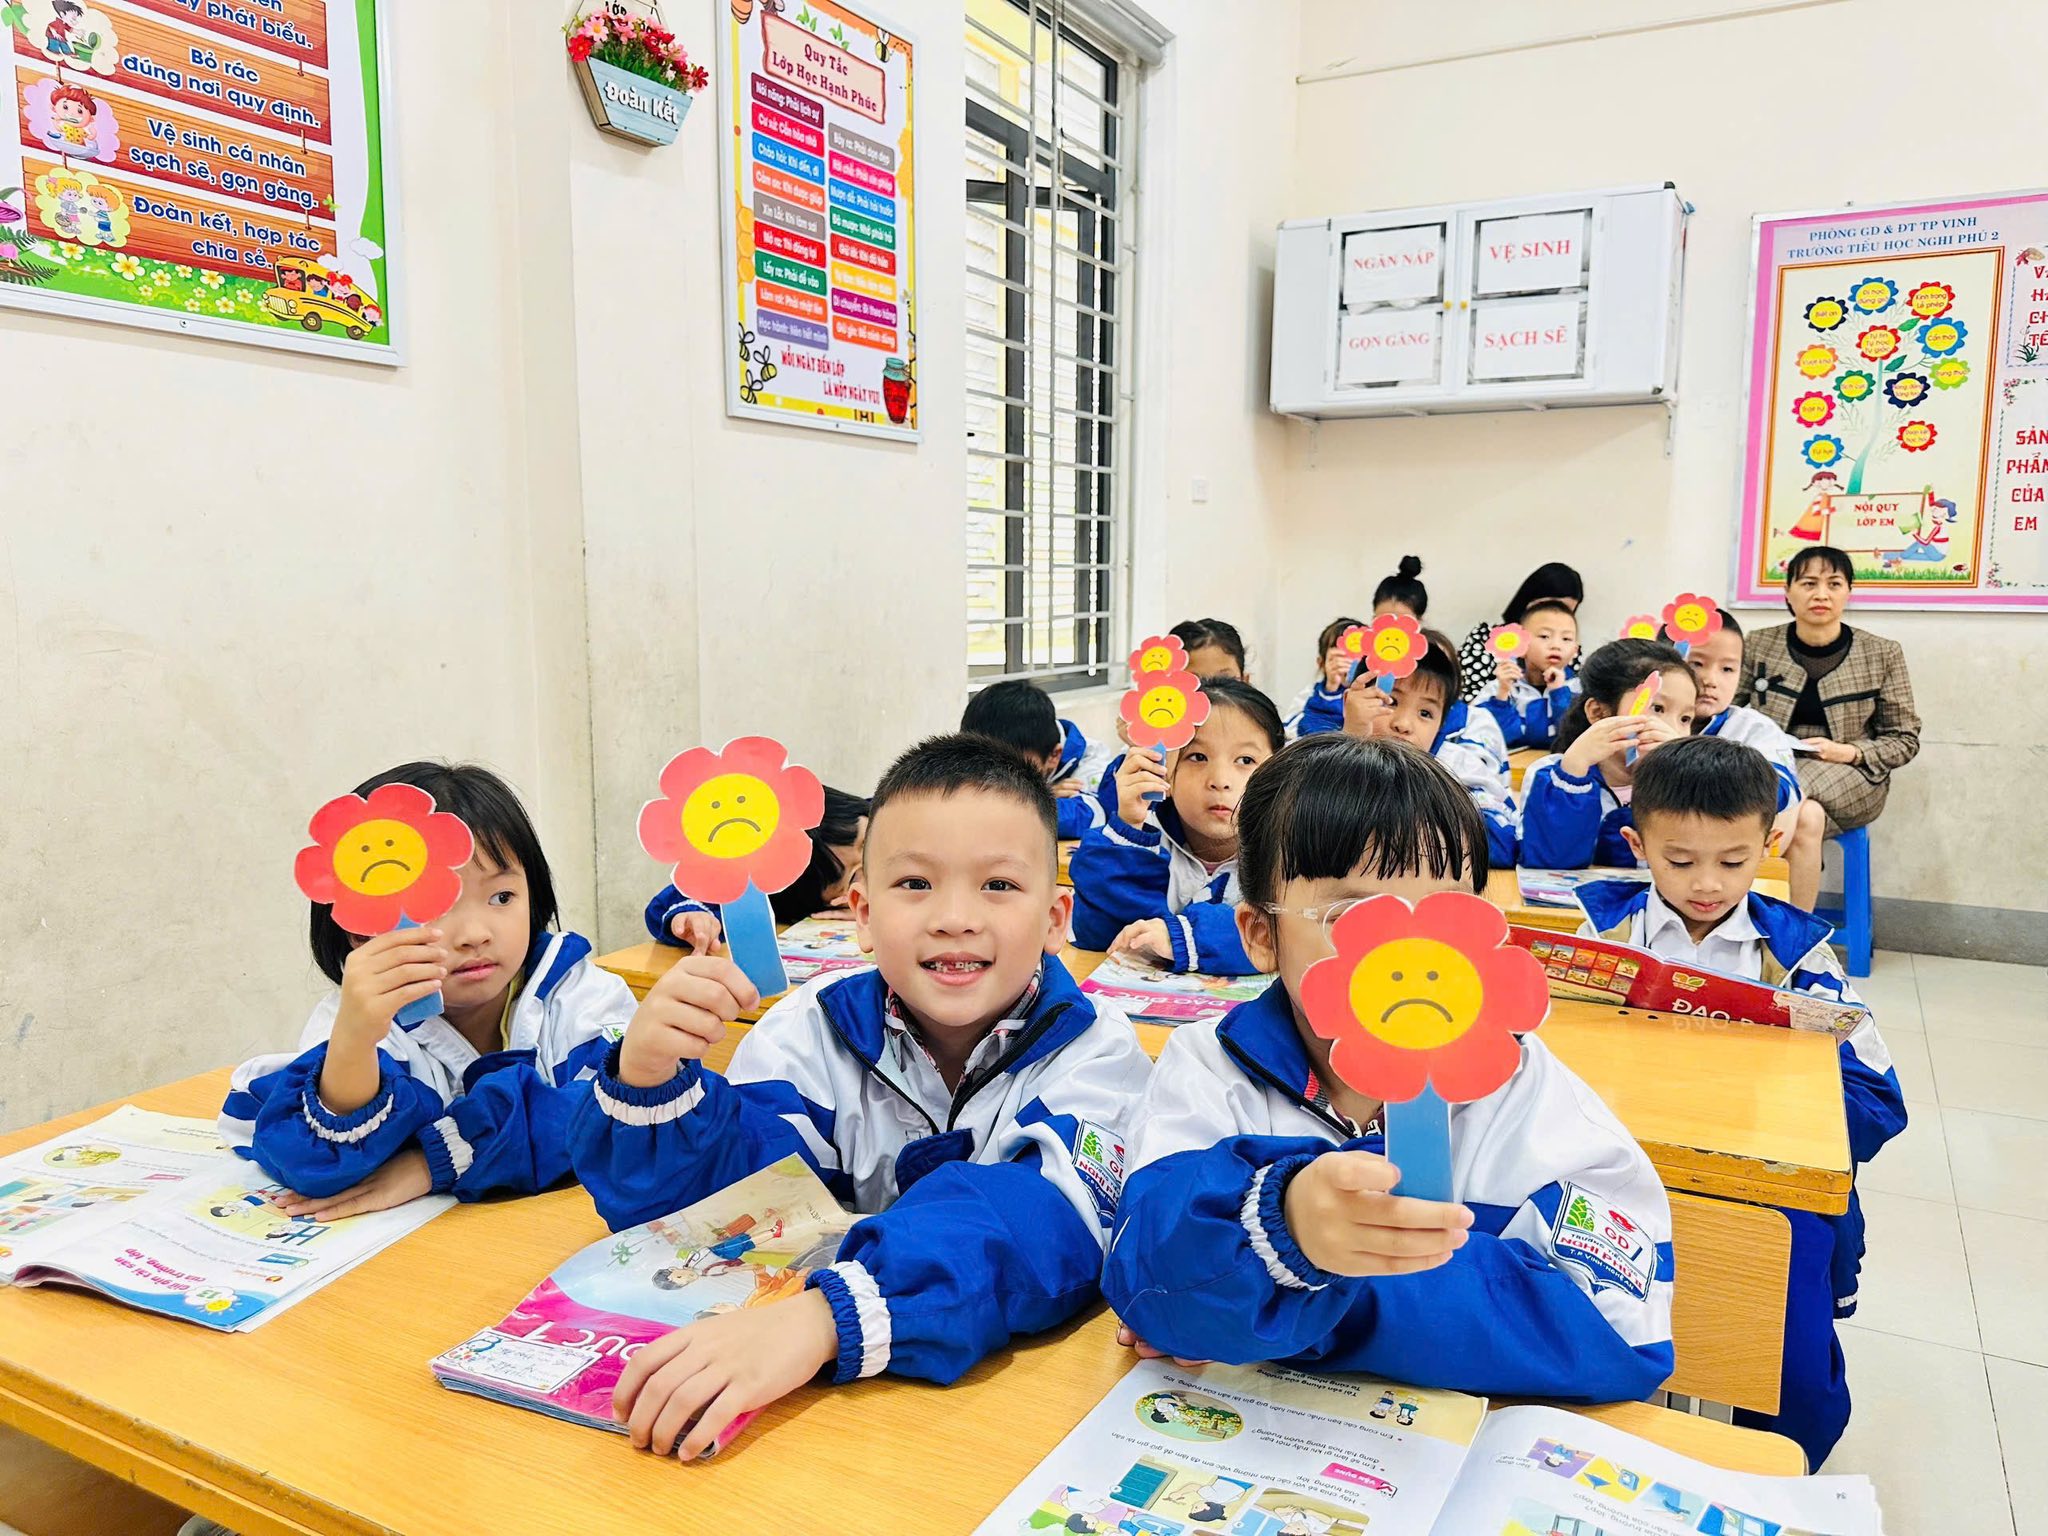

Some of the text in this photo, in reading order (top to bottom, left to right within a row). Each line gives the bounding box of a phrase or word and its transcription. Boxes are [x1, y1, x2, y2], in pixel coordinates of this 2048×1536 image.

[206, 1, 313, 49] phát biểu.
[190, 48, 260, 84] Bỏ rác
[804, 43, 849, 76] Quy Tắc
[123, 54, 321, 128] đúng nơi quy định.
[772, 50, 878, 113] Lớp Học Hạnh Phúc
[147, 119, 306, 177] Vệ sinh cá nhân
[131, 146, 181, 175] sạch
[221, 168, 259, 194] gọn
[264, 178, 319, 209] gàng.
[133, 196, 321, 253] Đoàn kết, hợp tác
[1808, 228, 1857, 243] PHÒNG
[1859, 224, 1880, 238] GD
[1883, 223, 1894, 235] &
[1920, 219, 1939, 232] TP
[1942, 215, 1978, 230] VINH
[191, 239, 273, 270] chia sẻ.
[1489, 239, 1571, 264] VỆ SINH
[1788, 243, 1845, 260] TRƯỜNG
[1847, 239, 1879, 255] TIỂU
[1884, 238, 1914, 252] HỌC
[1918, 234, 1953, 249] NGHI
[1991, 231, 2000, 241] 2
[1348, 332, 1431, 351] GỌN GÀNG
[1484, 329, 1538, 351] SẠCH
[2011, 483, 2045, 503] CỦA
[1875, 503, 1899, 514] QUY
[1879, 518, 1894, 527] EM
[2014, 516, 2037, 532] EM
[1560, 1237, 1599, 1255] NGHI
[1604, 1226, 1629, 1250] GD
[1380, 1431, 1394, 1440] Em
